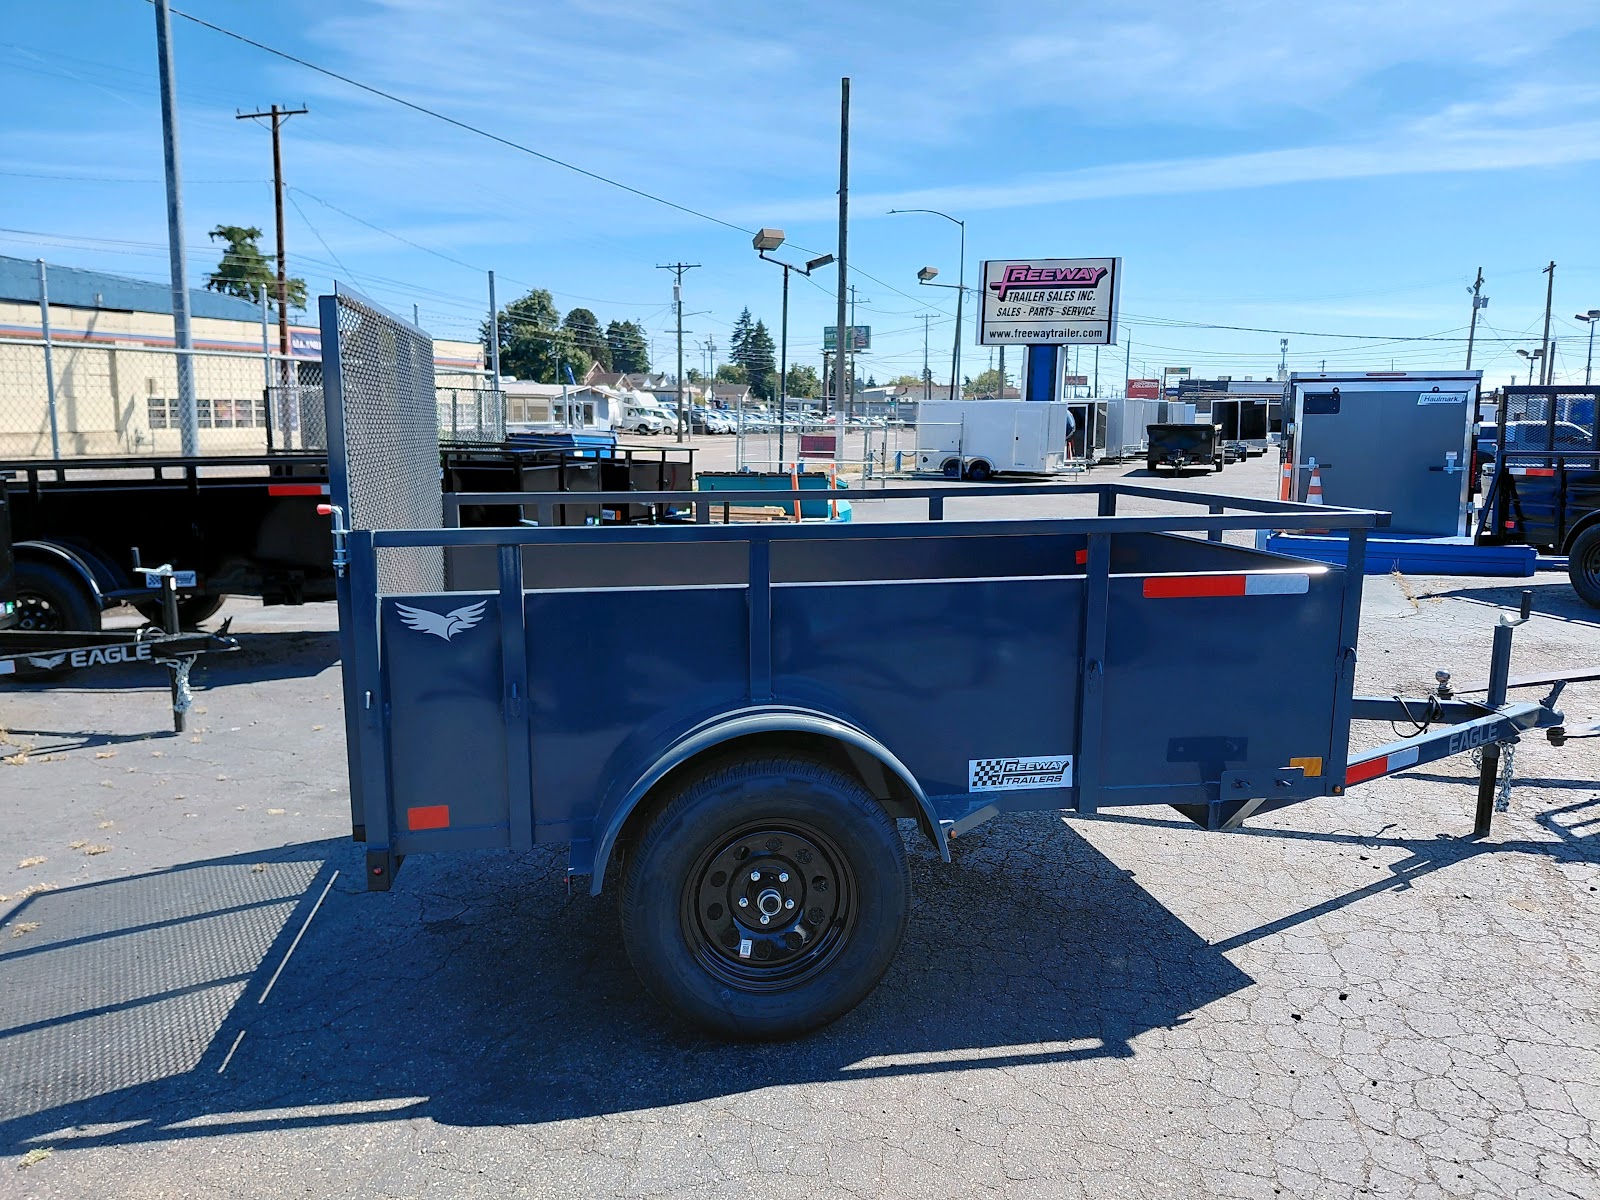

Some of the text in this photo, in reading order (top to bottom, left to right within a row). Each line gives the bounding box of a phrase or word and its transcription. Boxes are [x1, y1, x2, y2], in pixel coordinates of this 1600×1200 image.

[990, 265, 1108, 301] FREEWAY
[1009, 290, 1096, 302] TRAILER SALES INC.
[996, 307, 1021, 317] SALES
[1028, 306, 1055, 316] PARTS
[1061, 306, 1096, 316] SERVICE
[989, 328, 1103, 340] www.freewaytrailer.com
[70, 643, 152, 667] EAGLE
[1448, 722, 1498, 756] EAGLE
[992, 760, 1070, 785] FREEWAY
[1005, 775, 1062, 785] TRAILERS
